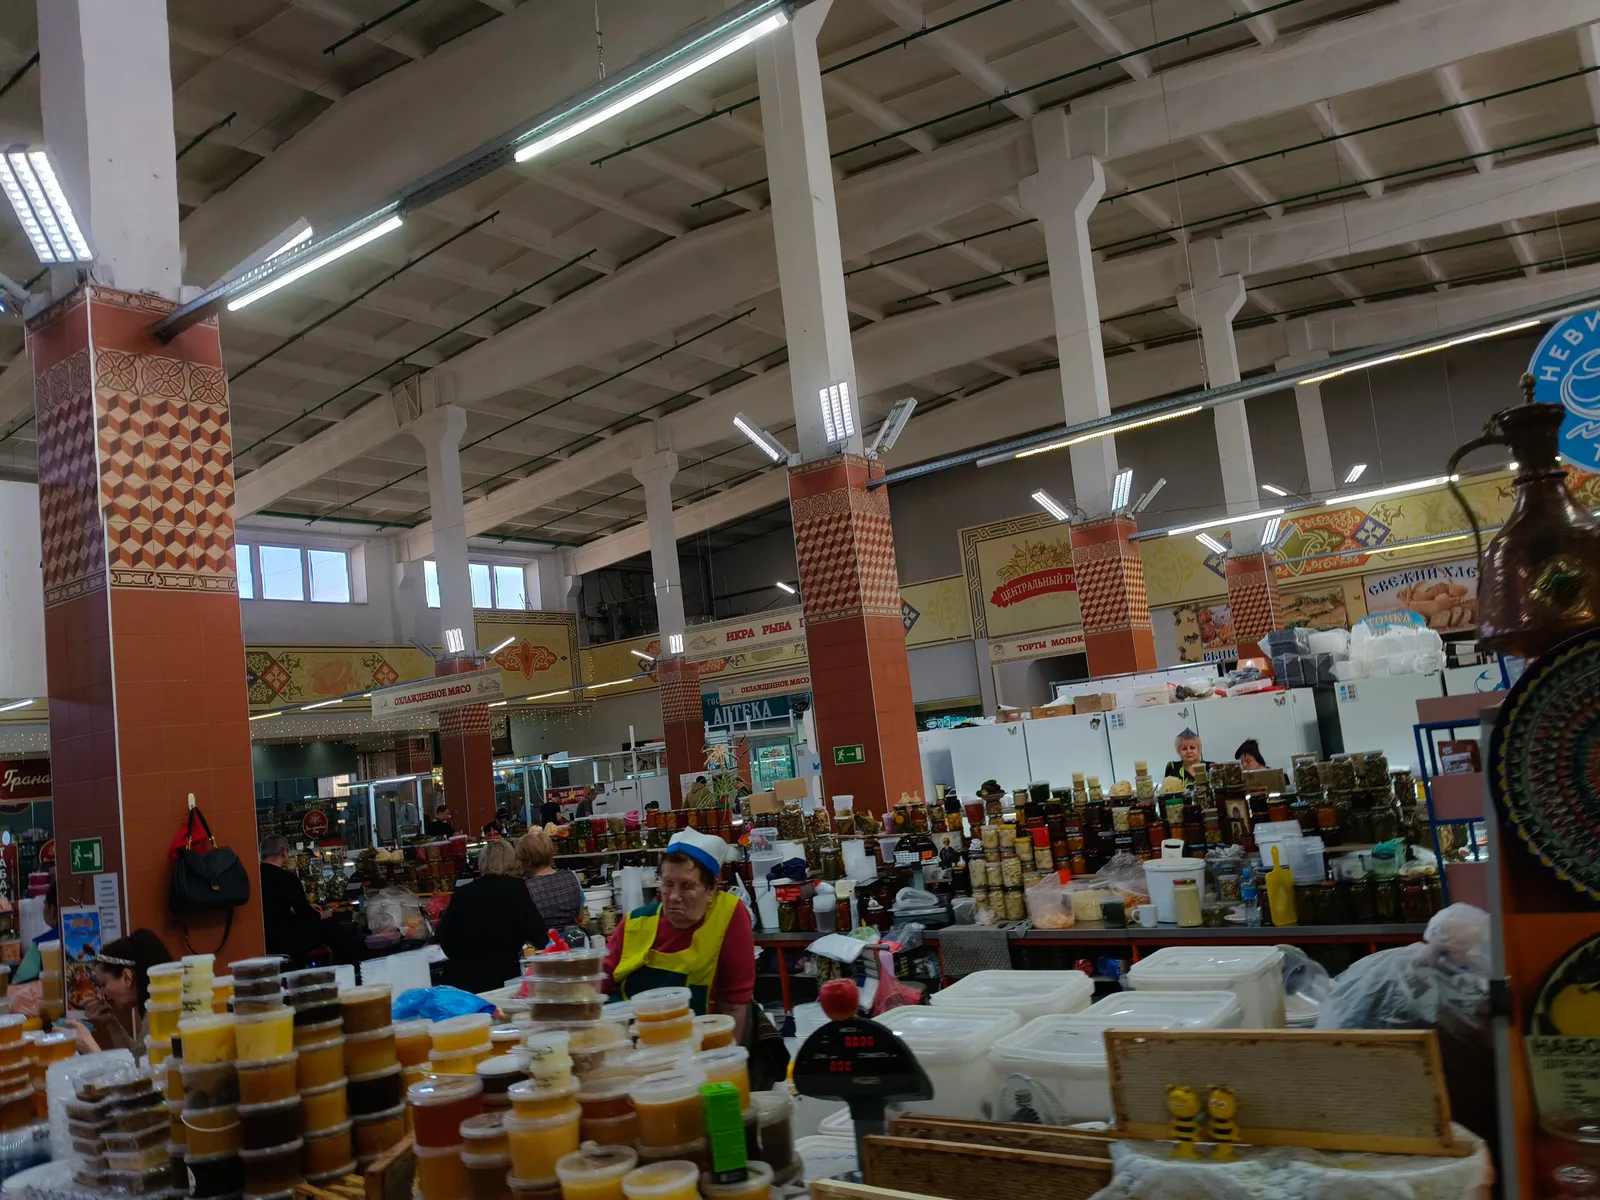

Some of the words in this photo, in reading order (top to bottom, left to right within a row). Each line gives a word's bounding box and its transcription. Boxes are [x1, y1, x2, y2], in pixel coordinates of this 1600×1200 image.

[1000, 573, 1063, 602] ЦЕНТРАЛЬНЫЙ
[1368, 565, 1438, 596] СВЕЖИЙ
[726, 627, 755, 642] ИКРА
[761, 621, 792, 635] РЫБА
[1017, 641, 1047, 652] ТОРТЫ
[1051, 635, 1084, 647] МОЛОК
[394, 688, 447, 706] ОХЛАЖДЕННОЕ
[448, 684, 472, 696] МЯСО
[740, 681, 789, 694] ОХЛАЖДЕННОЕ
[789, 676, 810, 686] МЯСО
[713, 700, 773, 725] АПТЕКА
